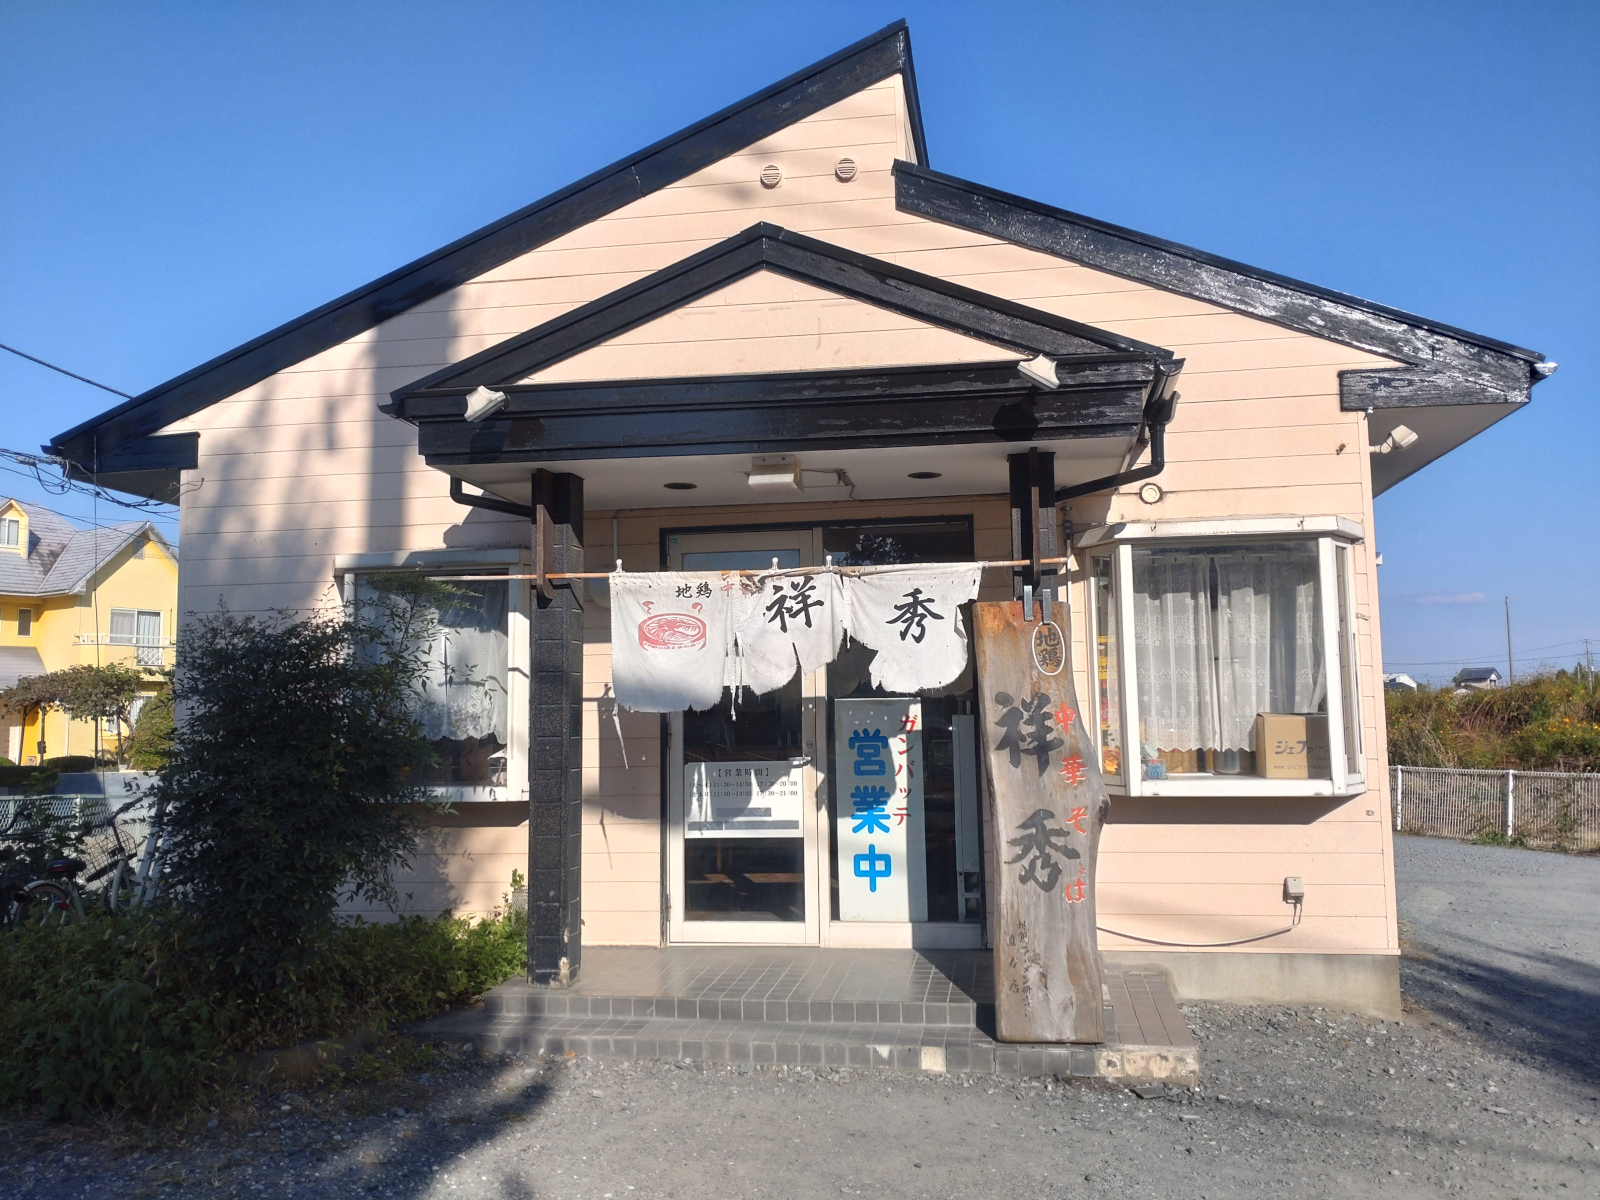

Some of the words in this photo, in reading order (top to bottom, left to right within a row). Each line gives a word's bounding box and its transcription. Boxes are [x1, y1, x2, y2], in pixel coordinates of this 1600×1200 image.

[675, 581, 713, 599] 地鶏
[765, 575, 945, 645] 祥秀
[1036, 626, 1062, 668] 地鶏
[848, 728, 892, 893] 営業中
[891, 713, 918, 827] ガンバッテ
[994, 691, 1081, 893] 祥秀
[1054, 701, 1089, 903] 中華そば
